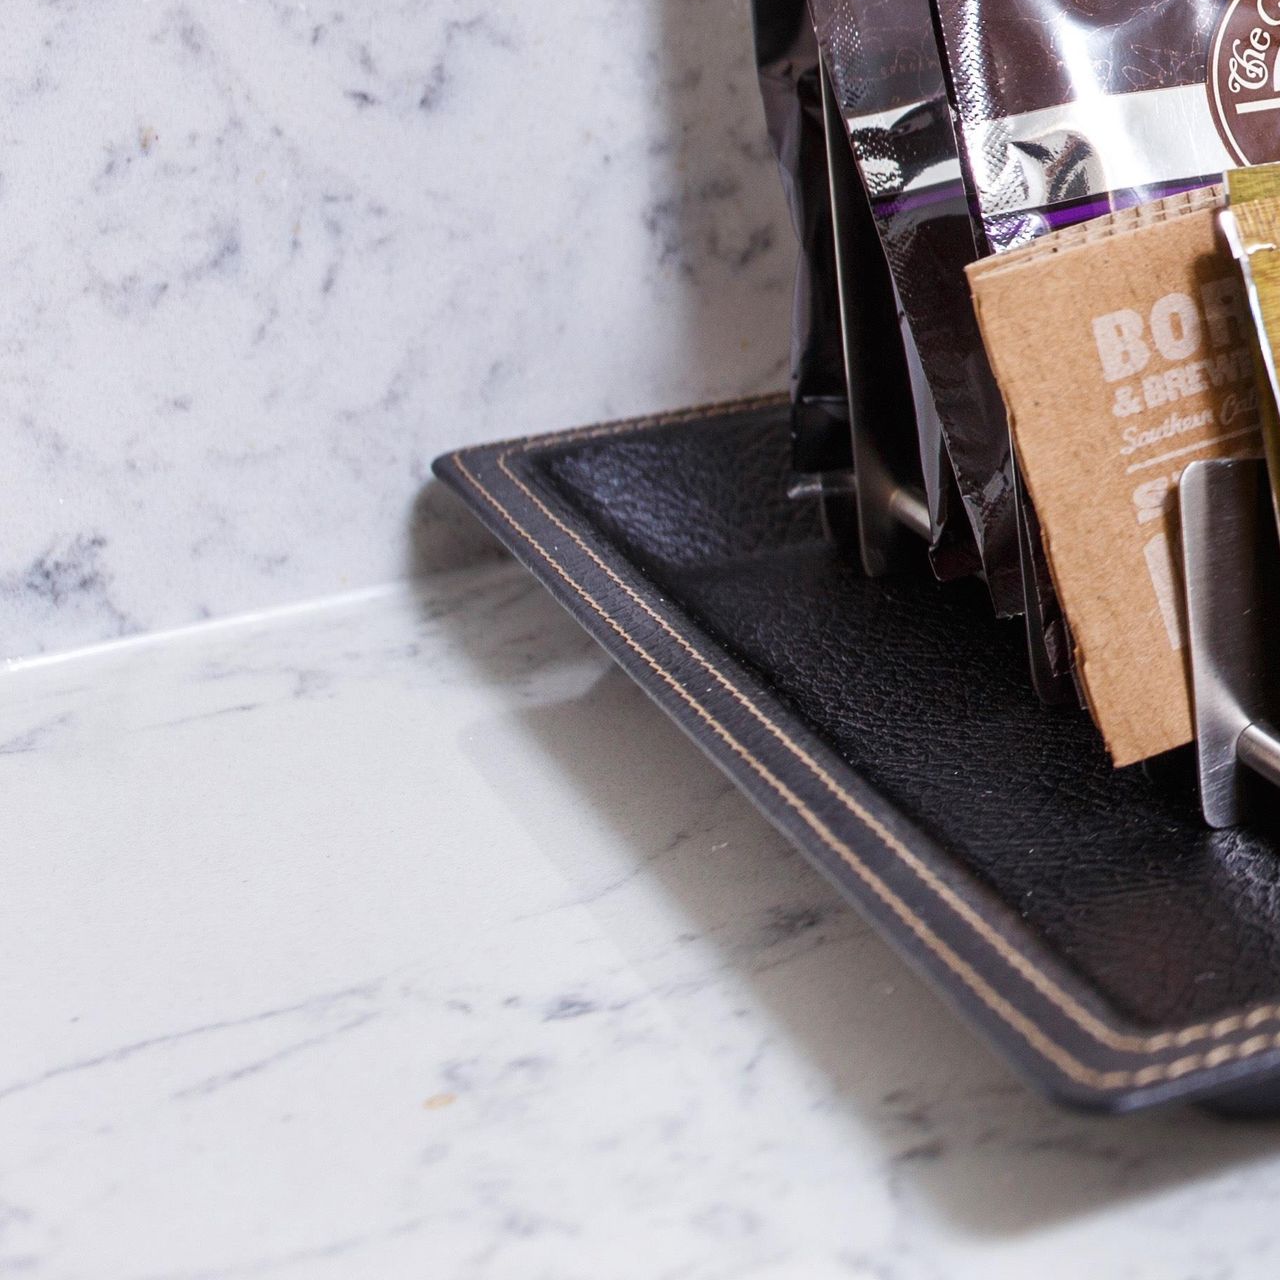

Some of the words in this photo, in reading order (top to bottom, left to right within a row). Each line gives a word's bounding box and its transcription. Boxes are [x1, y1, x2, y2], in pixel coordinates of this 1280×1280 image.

[1228, 26, 1271, 94] The
[1091, 275, 1256, 384] BOR
[1112, 385, 1144, 417] &
